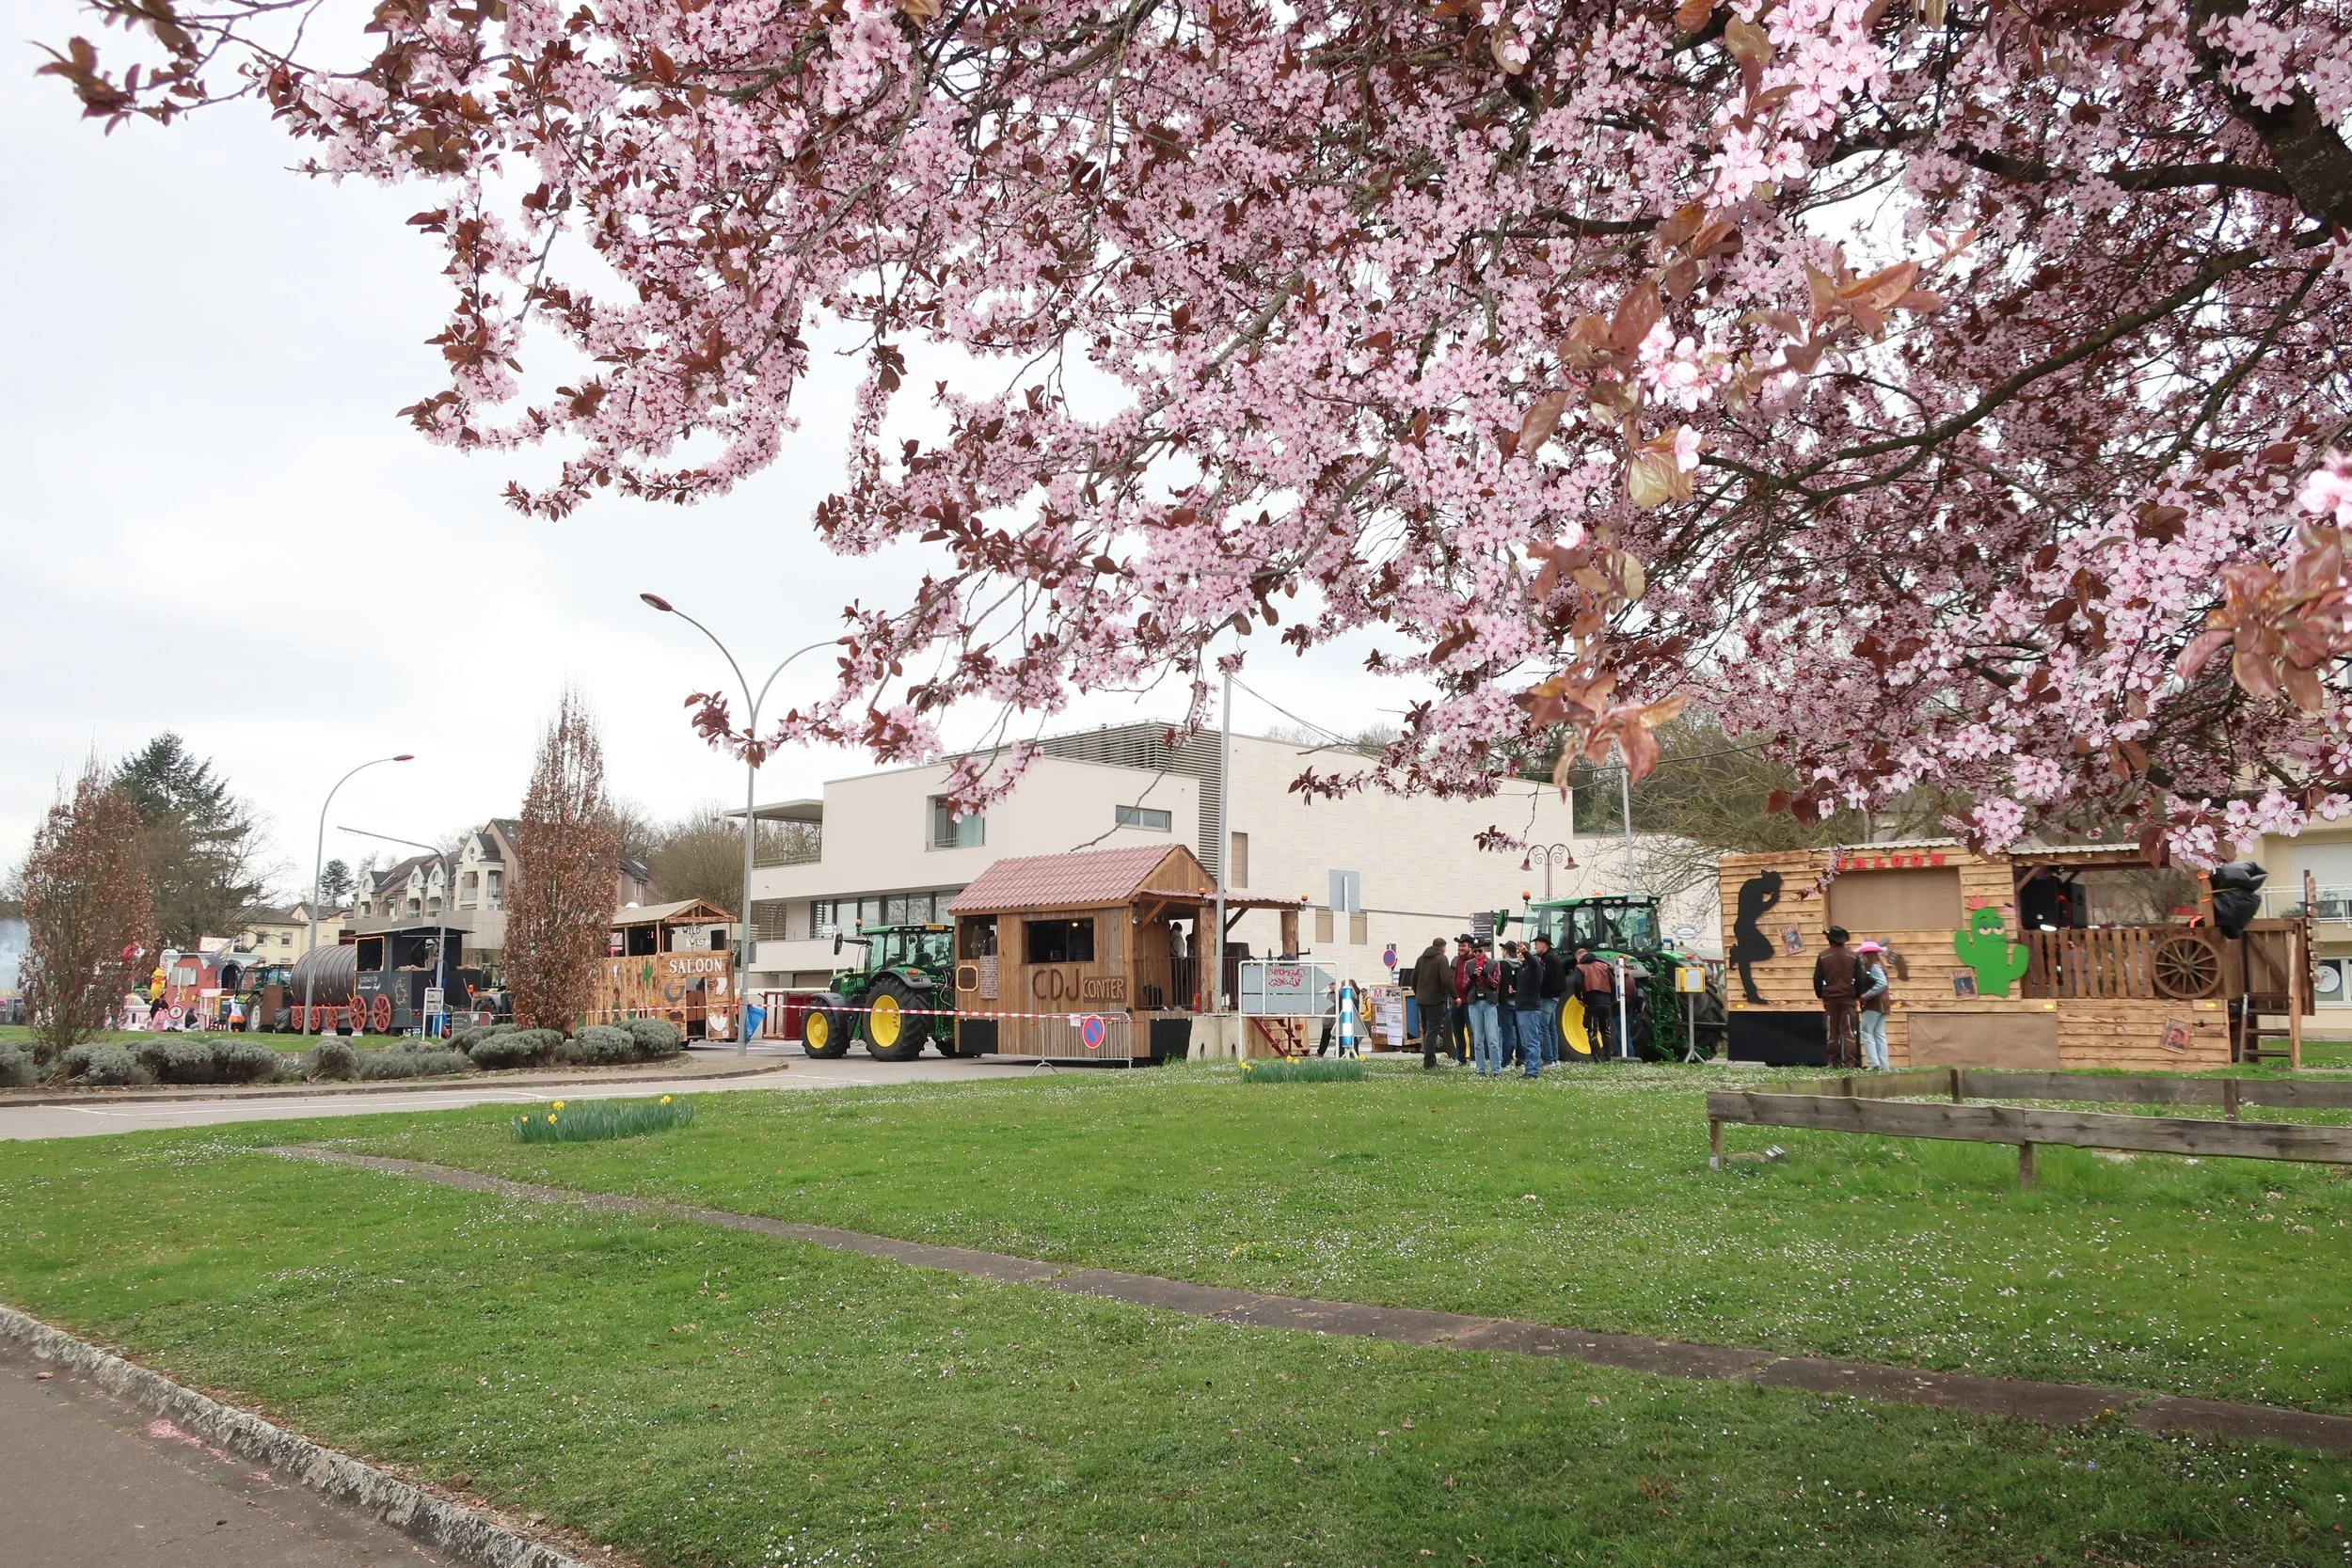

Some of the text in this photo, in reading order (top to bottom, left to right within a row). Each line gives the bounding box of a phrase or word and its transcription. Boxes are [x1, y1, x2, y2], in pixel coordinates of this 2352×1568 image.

[682, 927, 702, 935] WILD
[689, 938, 707, 947] WEST
[669, 958, 723, 974] SALOON
[1032, 968, 1124, 1001] CDJ CONTER
